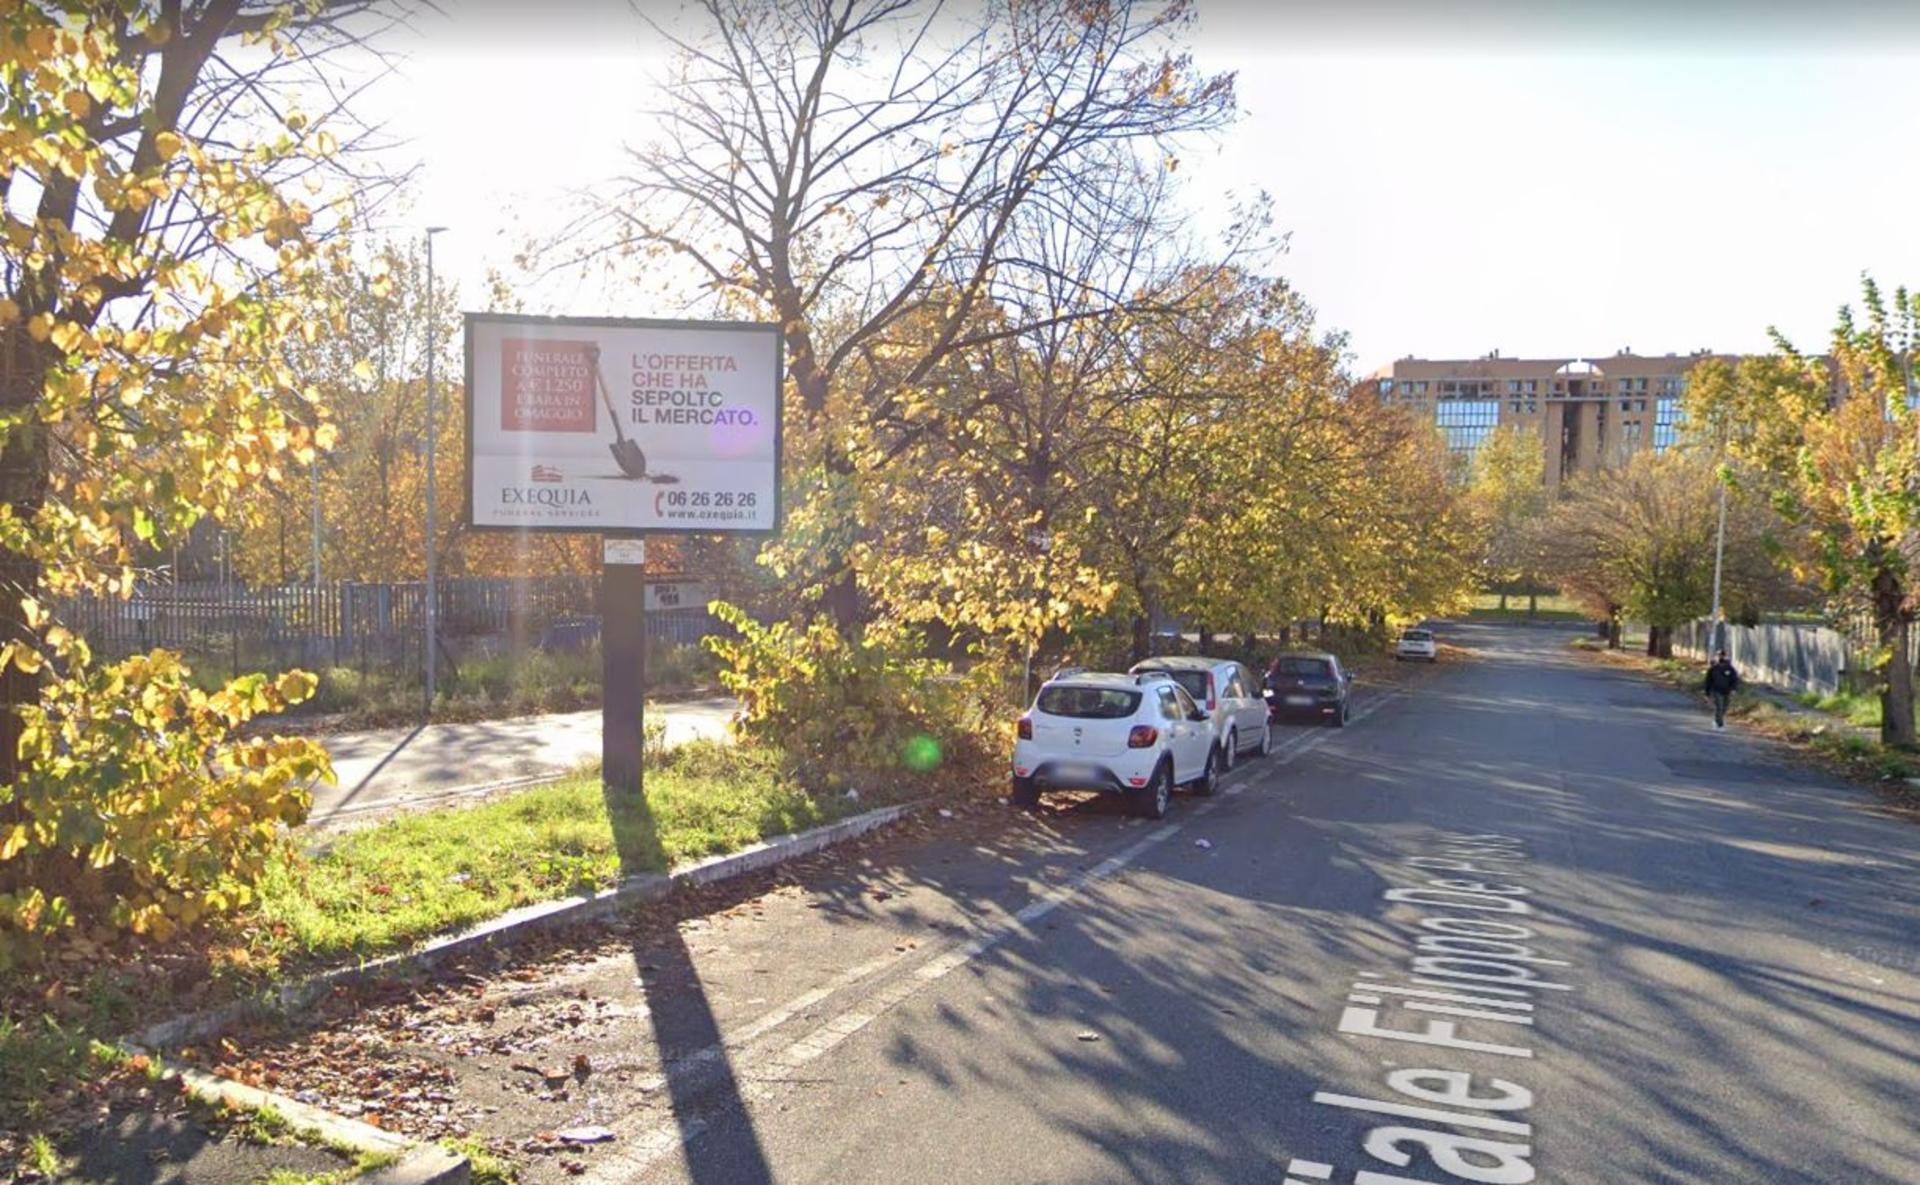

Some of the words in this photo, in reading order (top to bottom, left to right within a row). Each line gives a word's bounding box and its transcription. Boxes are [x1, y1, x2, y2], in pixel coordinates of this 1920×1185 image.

[631, 353, 737, 372] L'OFFERTA
[632, 371, 674, 388] CHE
[680, 372, 708, 389] HA
[632, 407, 649, 424] IL
[654, 408, 759, 426] MERCATO.
[501, 487, 592, 509] EXEQUIA
[667, 491, 687, 506] 06
[691, 491, 710, 506] 26
[714, 491, 734, 507] 26
[737, 492, 757, 507] 26
